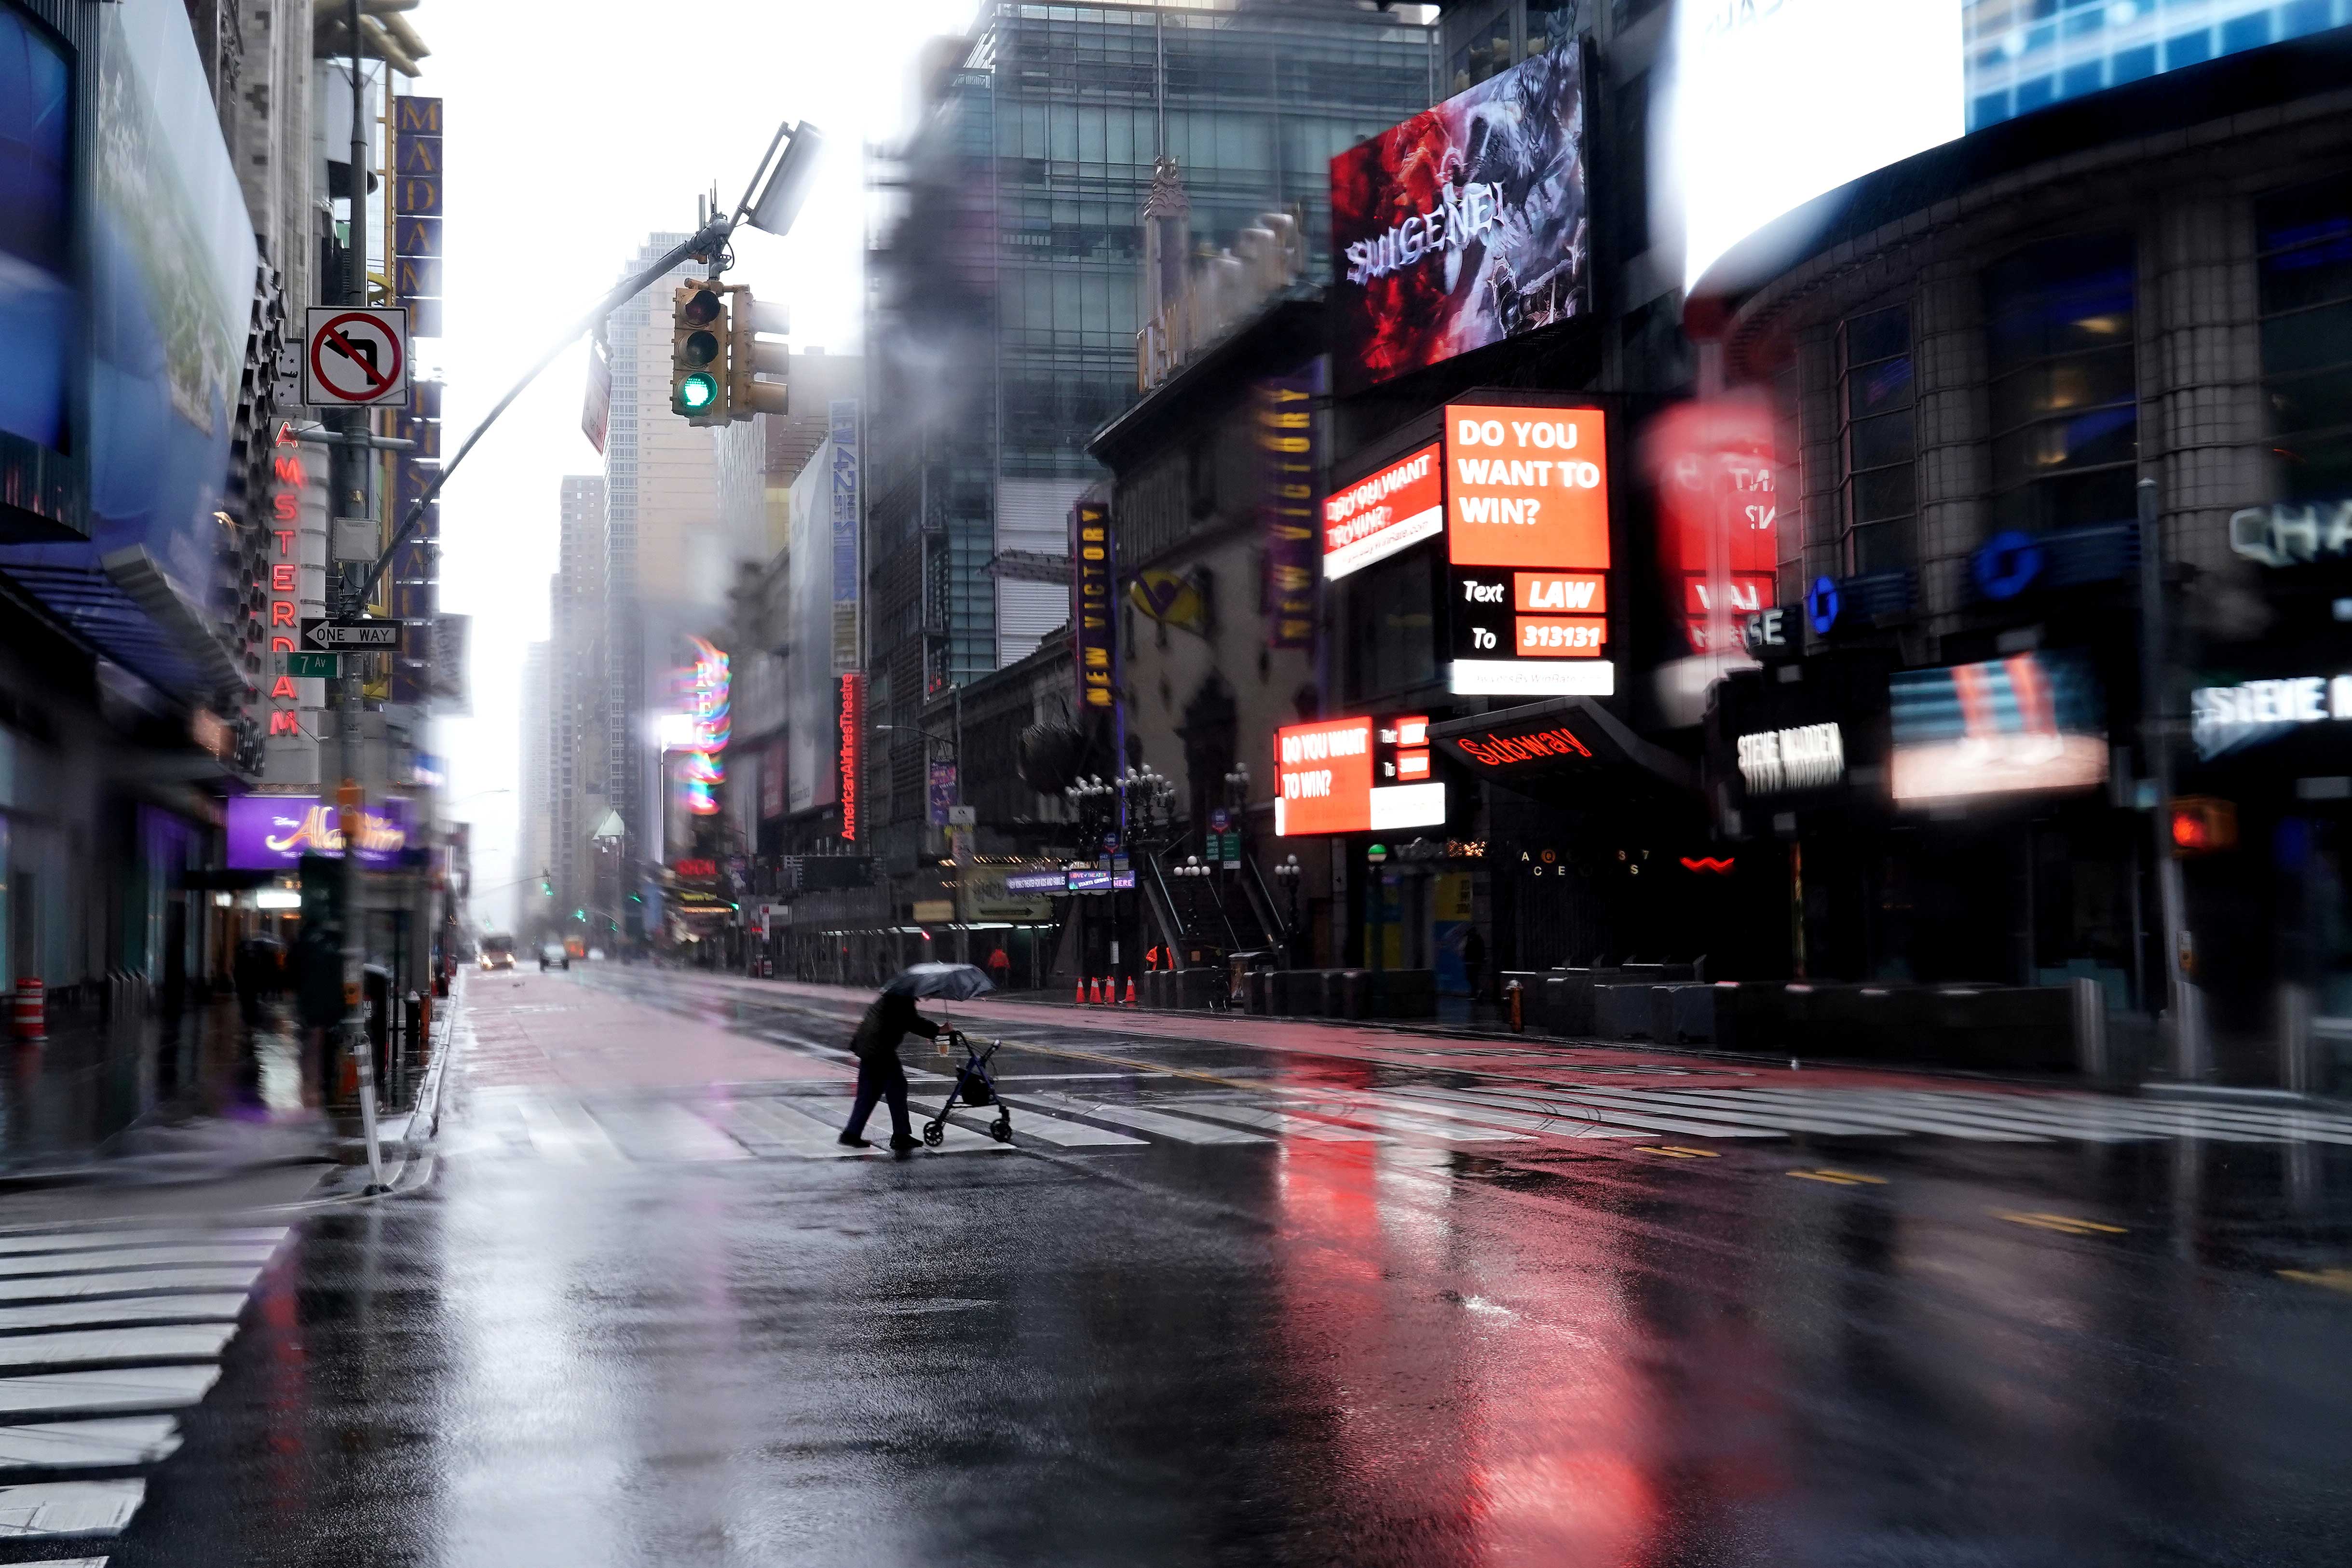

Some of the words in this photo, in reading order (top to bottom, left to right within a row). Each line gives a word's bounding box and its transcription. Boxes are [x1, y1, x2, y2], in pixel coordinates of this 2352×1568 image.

[1459, 419, 1504, 446] DO
[1511, 422, 1577, 449] YOU
[1381, 454, 1430, 493] WANT
[1458, 459, 1552, 487] WANT
[1558, 461, 1600, 488] TO
[1458, 497, 1540, 525] WIN?
[1082, 509, 1105, 629] VICTORY
[1463, 580, 1504, 603] Text
[1529, 581, 1596, 608] LAW
[317, 628, 345, 641] ONE
[359, 629, 390, 642] WAY
[1472, 628, 1496, 649] To
[1523, 625, 1600, 648] 313131
[300, 656, 309, 674] 7
[314, 656, 326, 668] Av
[1282, 736, 1302, 764] DO
[1302, 731, 1329, 760] YOU
[1458, 728, 1592, 766] Subway
[1282, 772, 1301, 799] TO
[1301, 769, 1332, 798] WIN?
[1521, 852, 1530, 861] A
[1533, 866, 1542, 876] C
[1558, 866, 1565, 876] E
